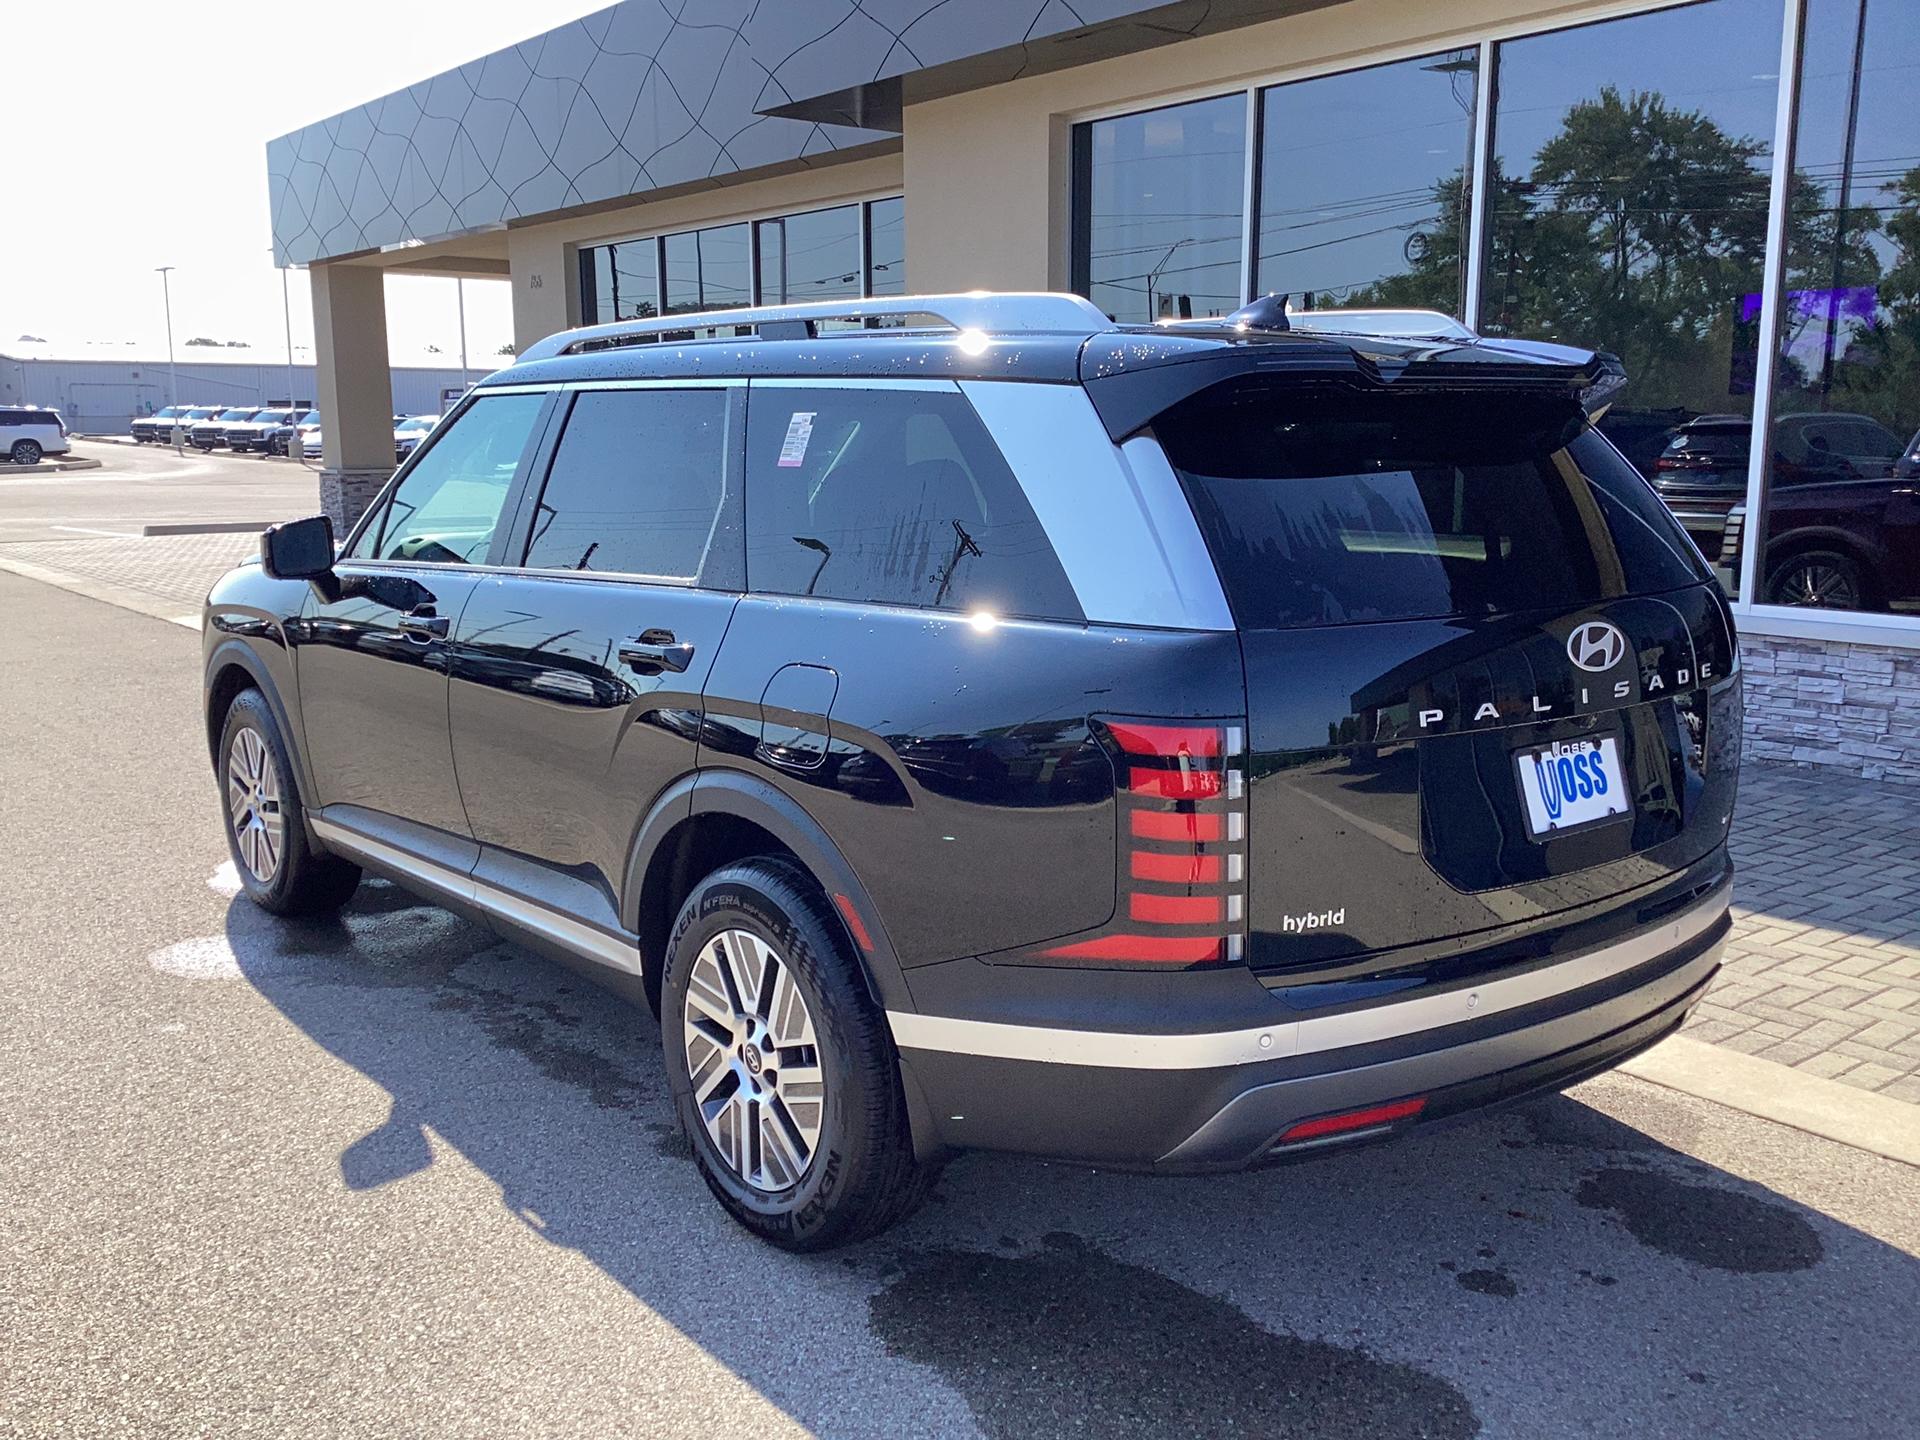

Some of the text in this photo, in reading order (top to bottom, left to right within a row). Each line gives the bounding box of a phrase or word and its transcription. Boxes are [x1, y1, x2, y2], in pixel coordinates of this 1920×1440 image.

[1420, 663, 1712, 727] PALISADE
[1535, 751, 1608, 820] VOSS
[1282, 907, 1345, 933] hybrid
